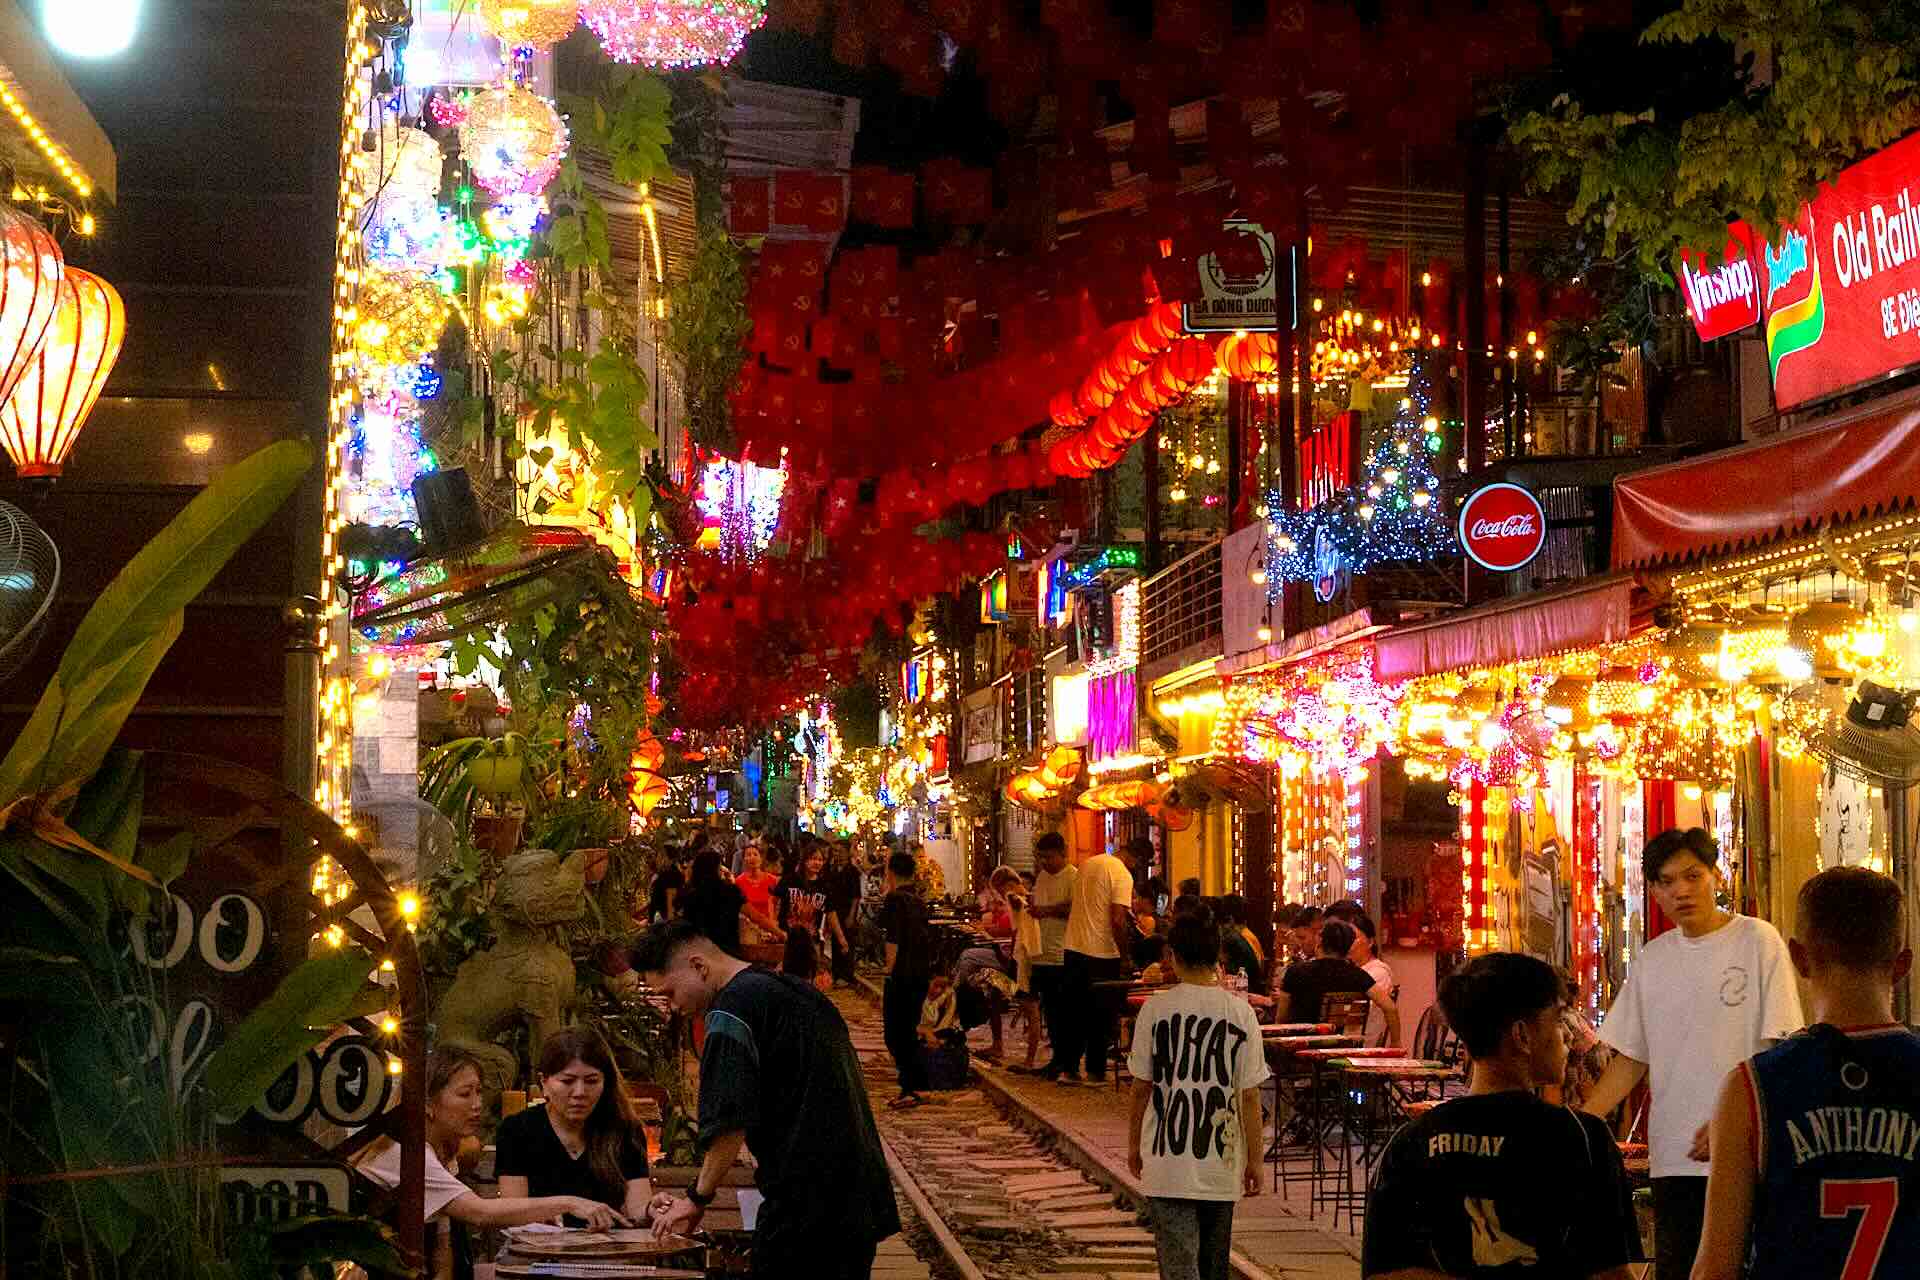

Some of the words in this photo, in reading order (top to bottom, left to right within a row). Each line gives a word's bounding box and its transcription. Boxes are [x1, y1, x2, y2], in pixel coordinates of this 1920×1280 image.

[1833, 211, 1873, 288] Old
[1152, 1012, 1247, 1089] WHAT
[1428, 1132, 1505, 1158] FRIDAY
[1786, 1105, 1920, 1166] ANTHONY
[1819, 1176, 1899, 1280] 7
